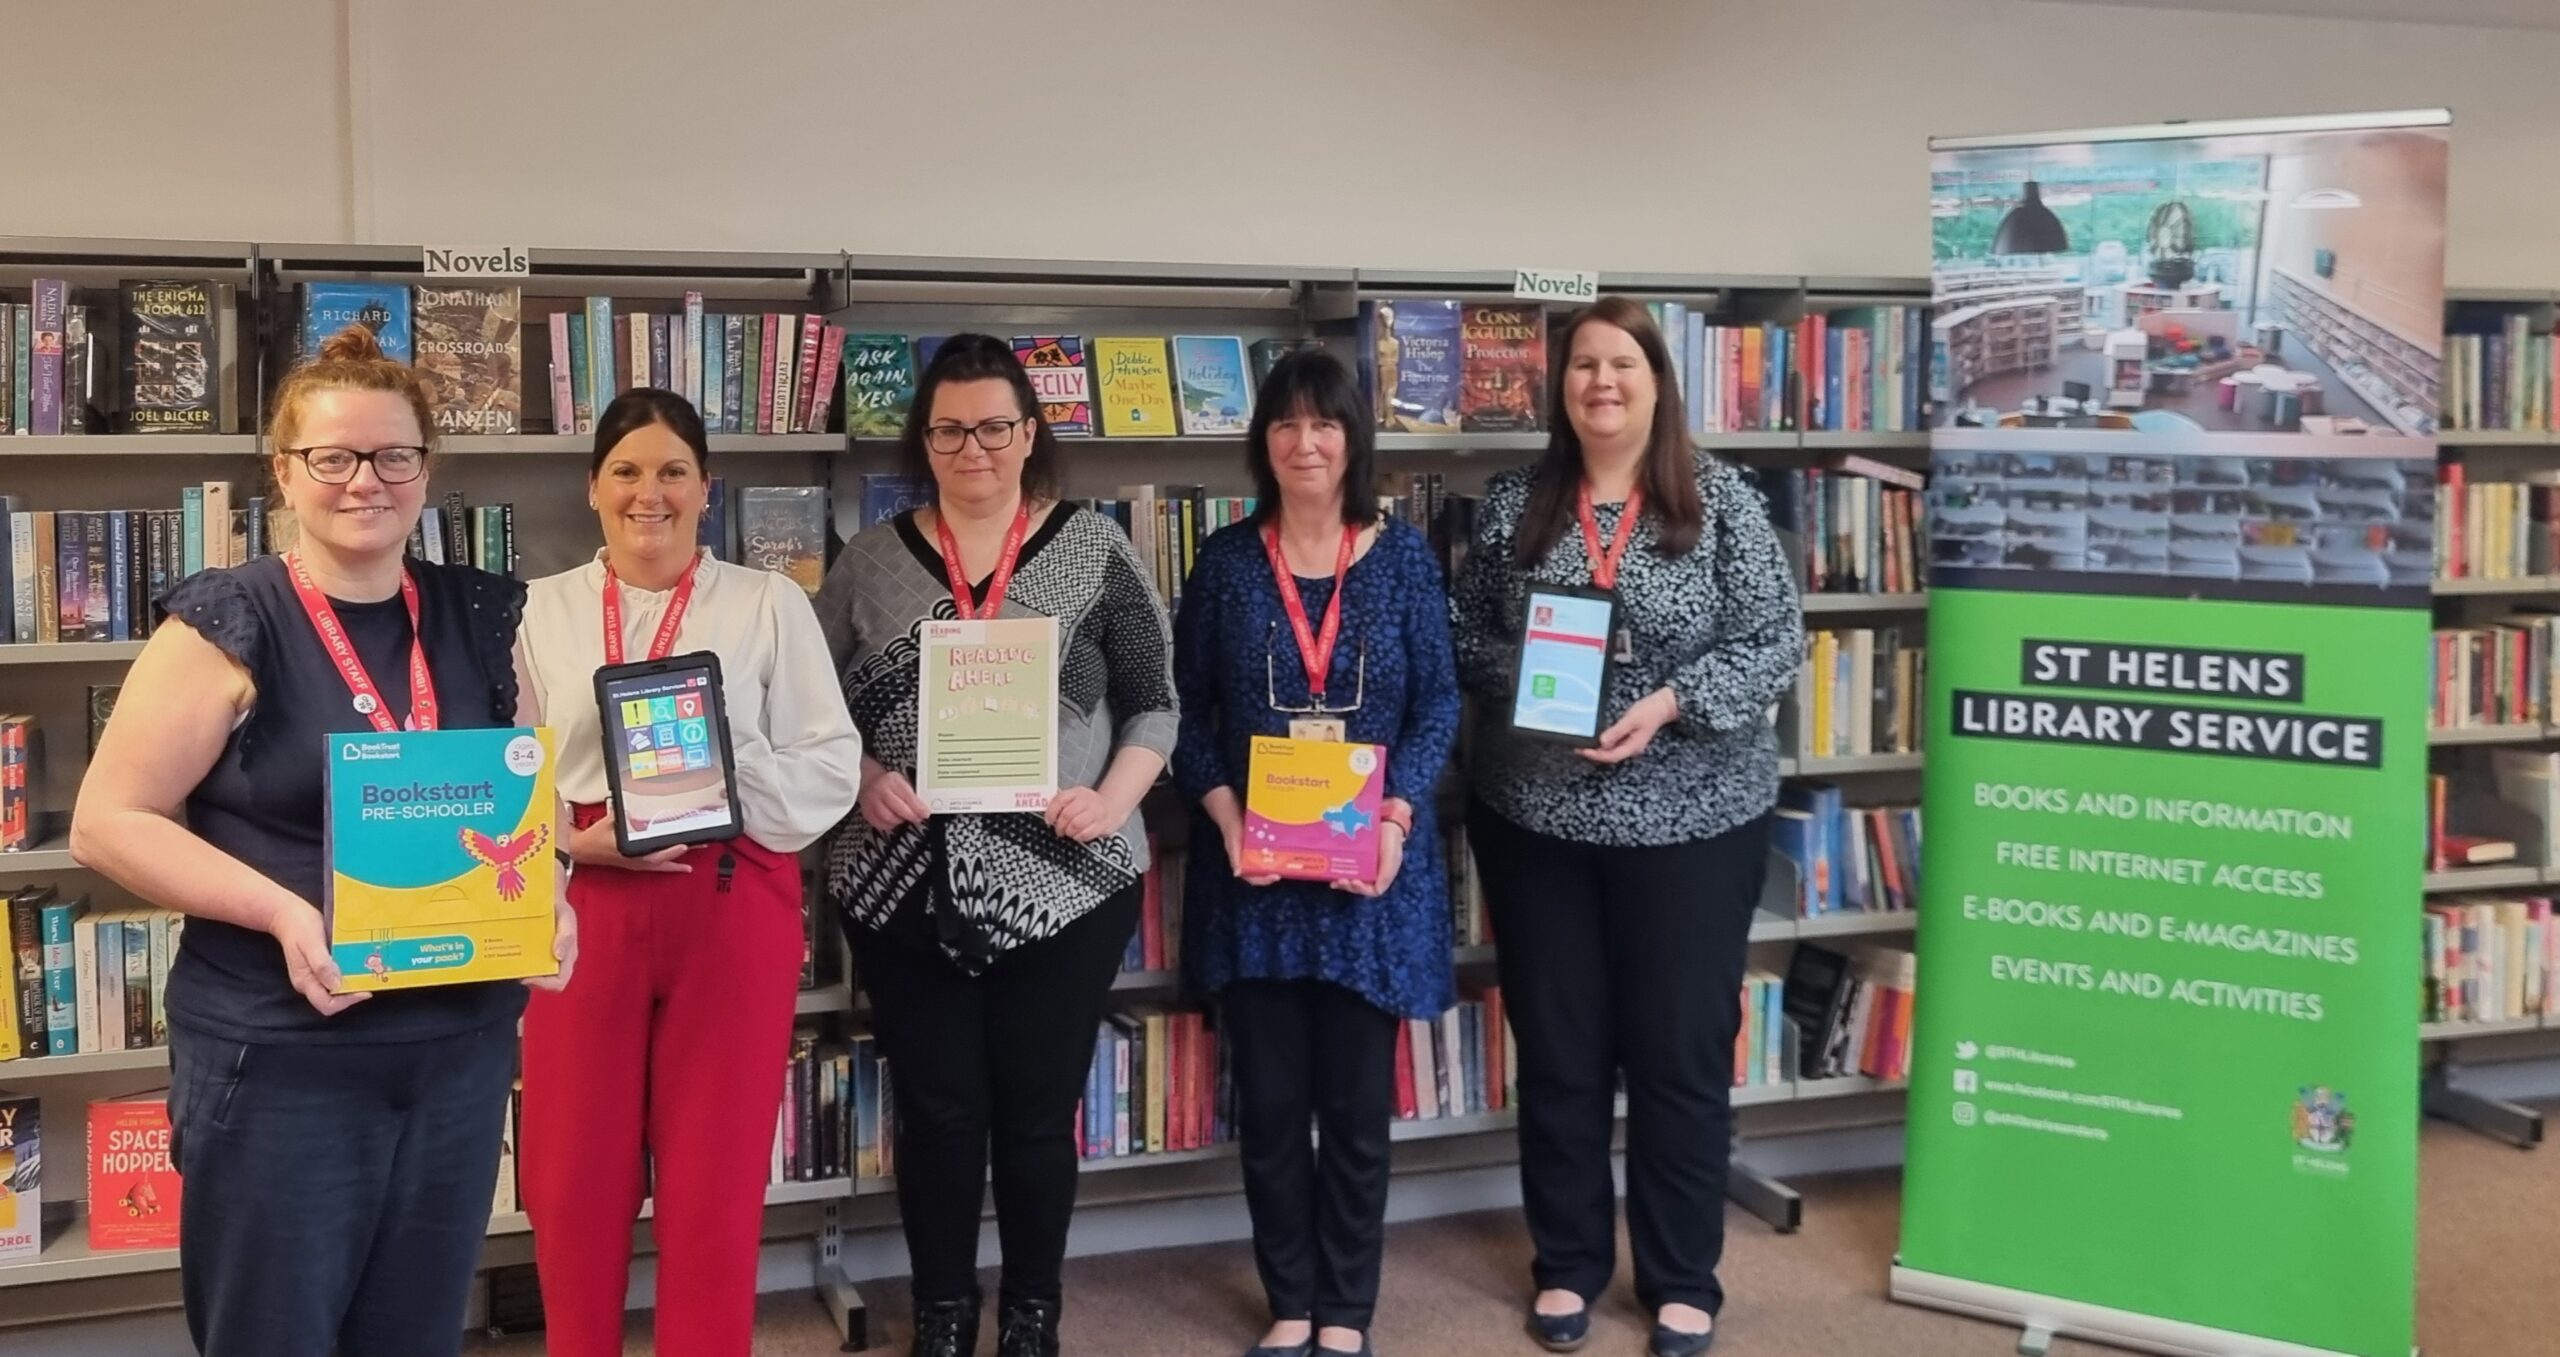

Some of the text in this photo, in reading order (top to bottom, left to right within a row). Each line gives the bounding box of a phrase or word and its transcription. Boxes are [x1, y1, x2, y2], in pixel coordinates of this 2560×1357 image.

[426, 247, 527, 273] Novels
[1519, 272, 1593, 297] Novels
[133, 290, 206, 302] THE ENIGMA
[417, 291, 511, 307] JONATHAN
[47, 287, 57, 328] NADINE
[144, 304, 181, 316] ROOM
[186, 303, 206, 315] 622
[323, 310, 391, 322] RICHARD
[1475, 308, 1521, 325] CONN
[1462, 322, 1537, 340] IGGULDEN
[418, 341, 511, 354] CROSSROADS
[1400, 335, 1447, 350] Victoria
[854, 349, 897, 367] ASK
[1030, 373, 1083, 397] ECILY
[1114, 379, 1155, 393] Maybe
[1399, 371, 1448, 384] Figurine
[856, 391, 896, 408] YES
[1107, 393, 1163, 407] One Day
[163, 411, 210, 422] DICKER
[453, 520, 463, 556] FRANCIS
[750, 536, 802, 553] Sarah's
[655, 597, 685, 655] LIBRARY STAFF
[930, 627, 962, 635] READING
[316, 609, 368, 690] LIBRARY STAFF
[950, 647, 1037, 667] READING
[2033, 645, 2291, 697] ST HELENS
[949, 670, 1015, 692] AHEAD
[1961, 697, 2370, 761] LIBRARY SERVICE
[512, 750, 535, 761] 3-4
[1266, 773, 1331, 789] Bookstart
[362, 781, 494, 804] Bookstart
[362, 802, 495, 821] PRE-SCHOOLER
[1015, 798, 1049, 809] AHEAD
[1973, 782, 2353, 840] BOOKS AND INFORMATION
[1996, 840, 2325, 899] FREE INTERNET ACCESS
[1963, 894, 2360, 966] E-BOOKS AND E-MAGAZINES
[420, 941, 465, 953] What's in
[411, 952, 465, 966] your pack?
[53, 969, 61, 991] Ever
[1991, 954, 2325, 1023] EVENTS AND ACTIVITIES
[109, 1129, 170, 1151] SPACE
